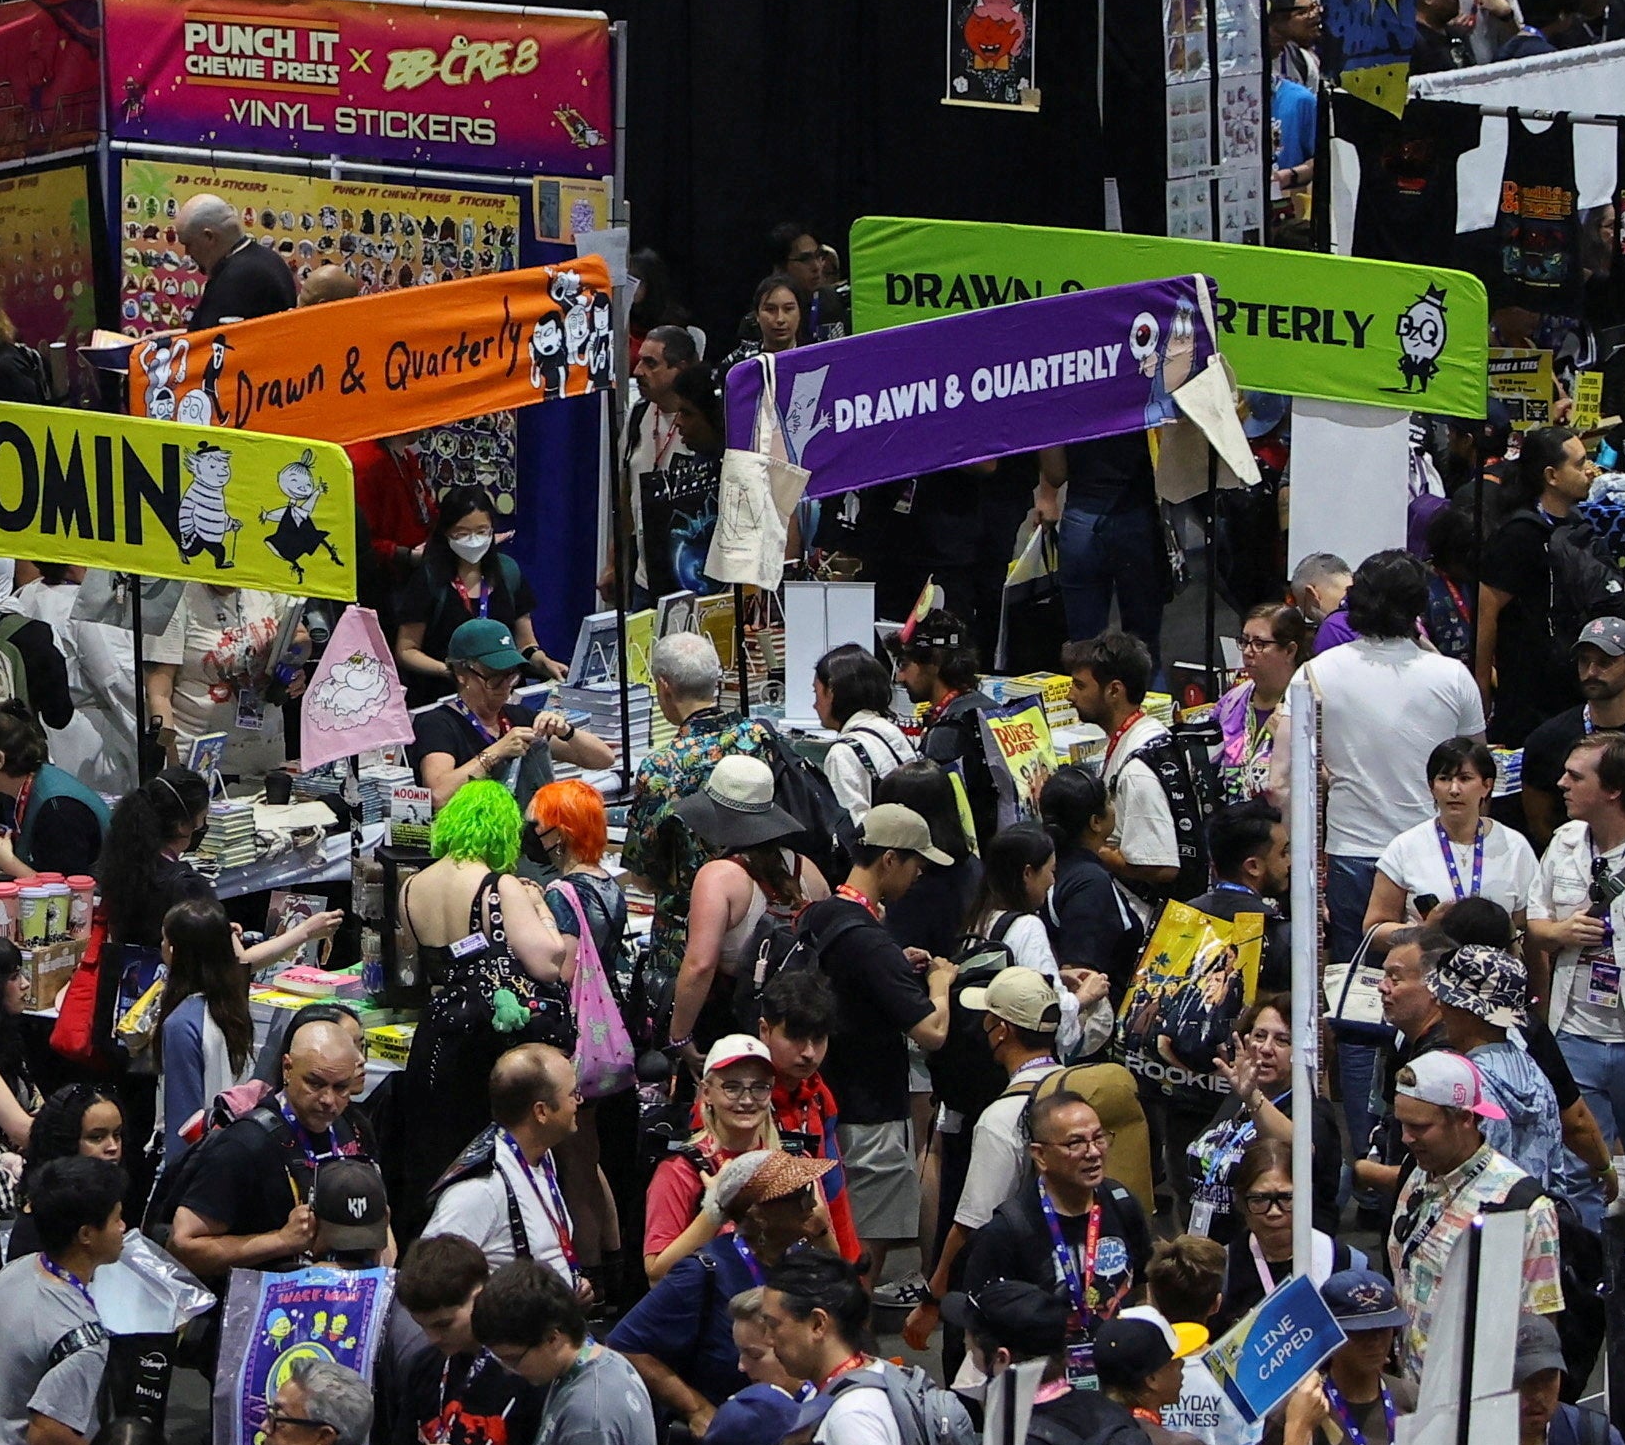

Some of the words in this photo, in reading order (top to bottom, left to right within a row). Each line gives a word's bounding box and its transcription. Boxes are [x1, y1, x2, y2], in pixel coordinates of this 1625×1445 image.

[182, 52, 265, 81] CHEWIE
[272, 63, 340, 85] PRESS
[229, 97, 324, 132] VINYL
[333, 106, 498, 147] STICKERS
[331, 185, 366, 198] PUNCH
[457, 194, 507, 210] STICKERS
[231, 363, 325, 428] Drawn
[341, 345, 367, 392] &
[383, 296, 523, 395] Quarterly
[834, 380, 938, 435] DRAWN
[944, 371, 964, 409] &
[969, 342, 1122, 403] QUARTERLY
[392, 788, 429, 802] MOOMIN
[1124, 1053, 1234, 1095] ROOKIE
[1253, 1313, 1298, 1359] LINE
[1258, 1325, 1316, 1382] CAPPED
[134, 1384, 163, 1401] hulu
